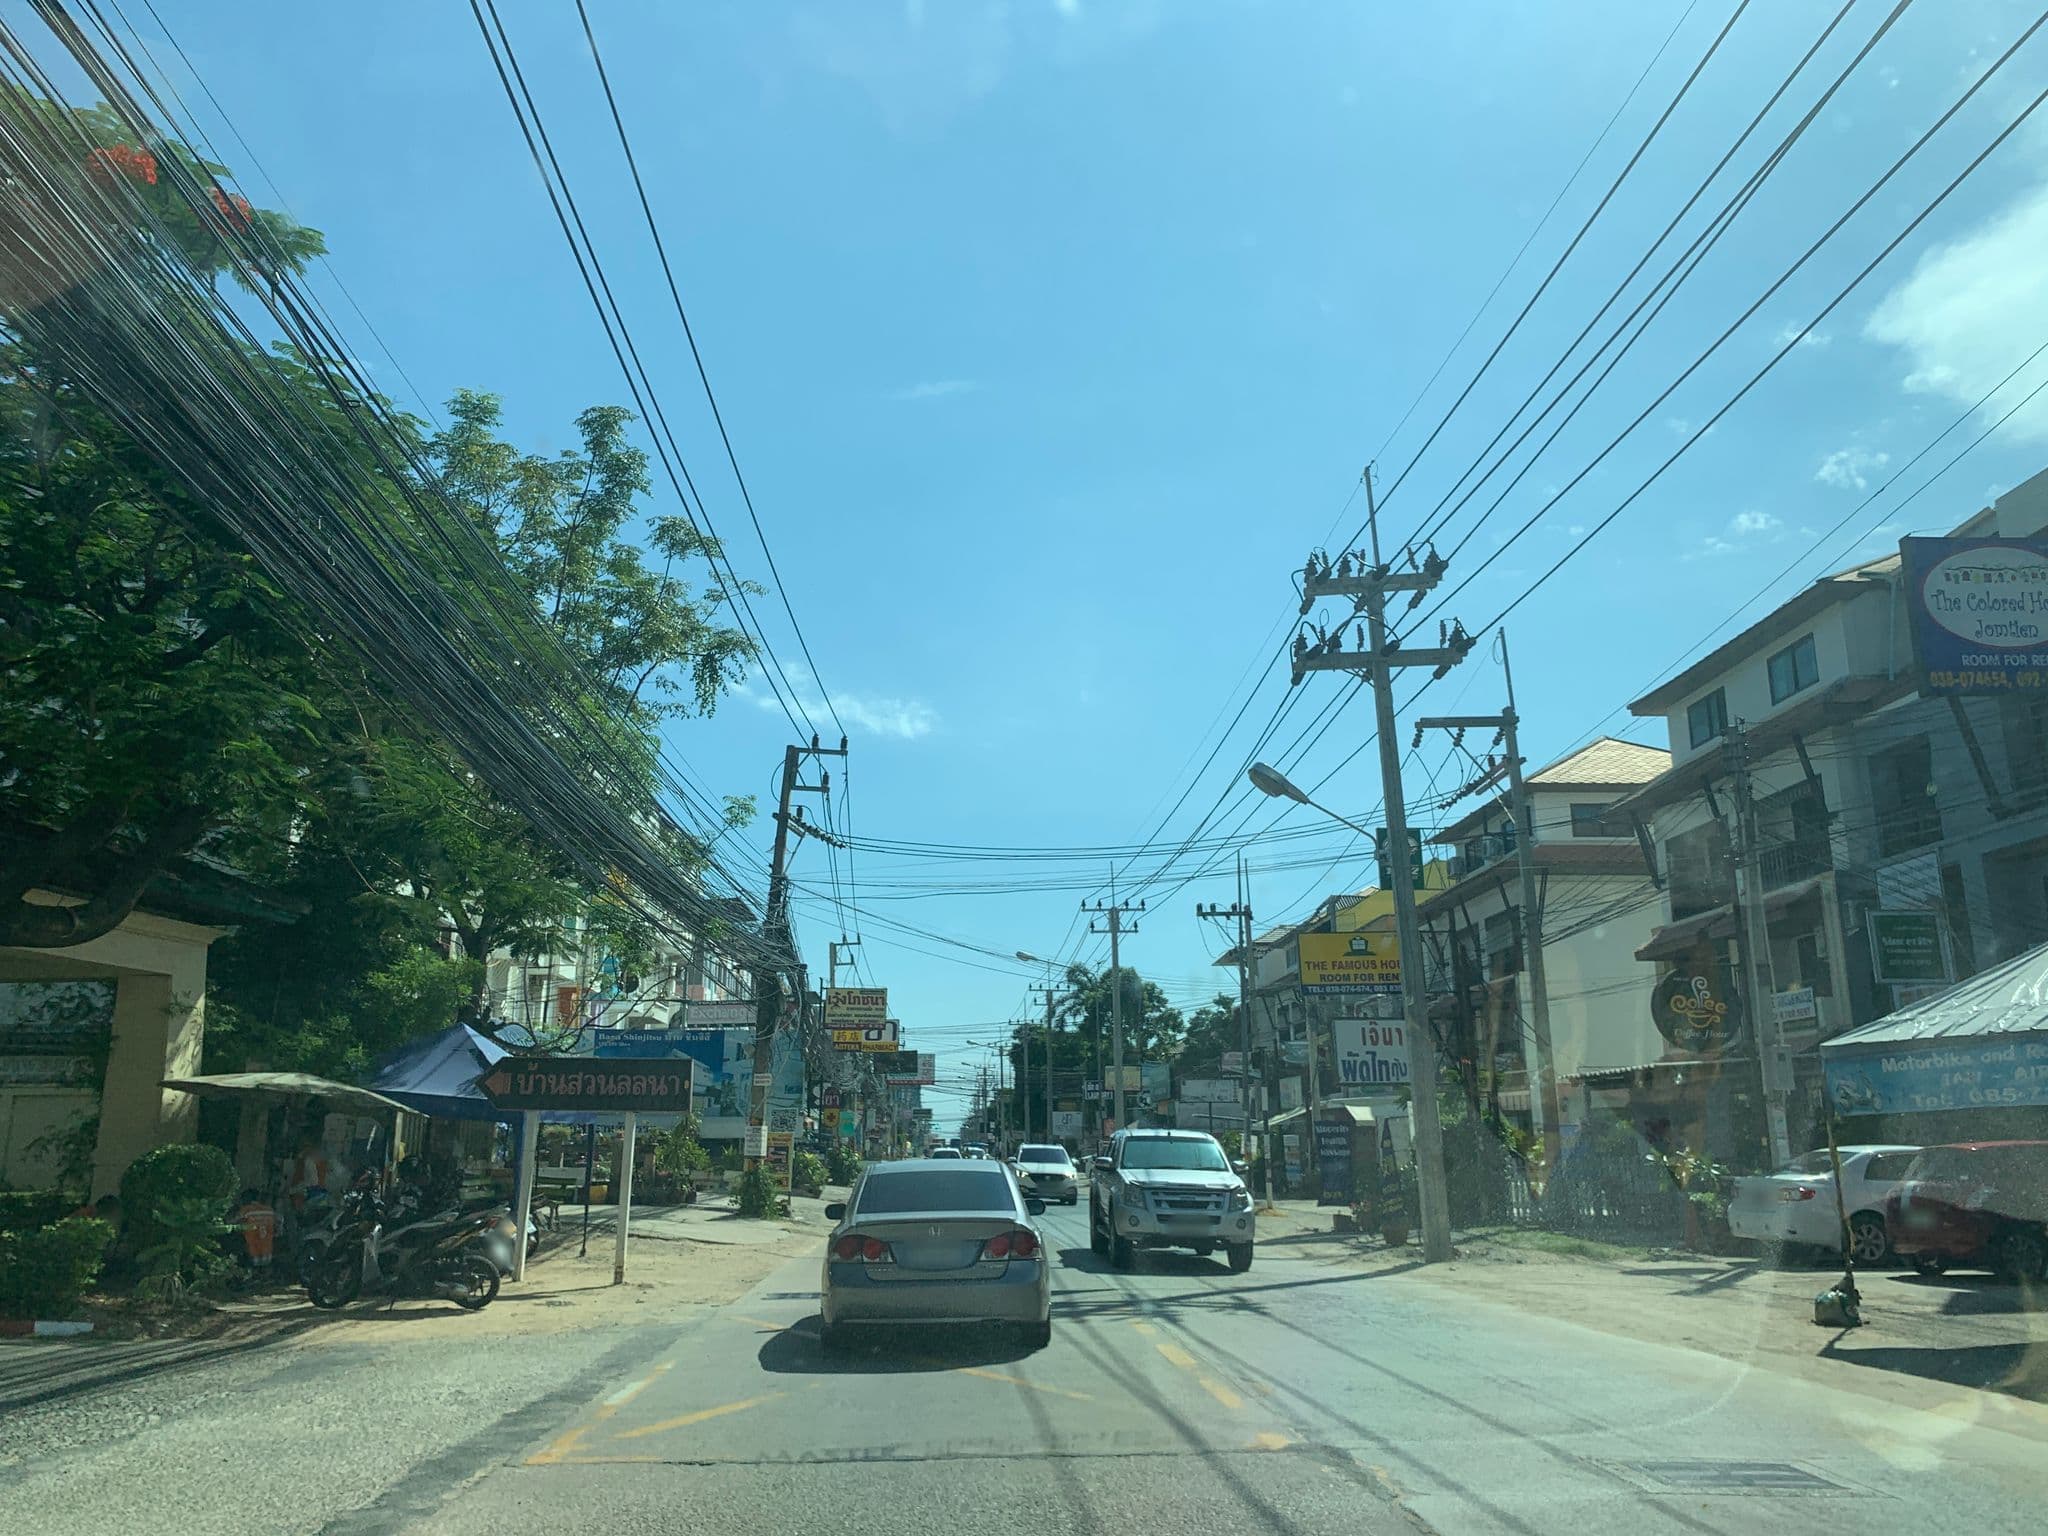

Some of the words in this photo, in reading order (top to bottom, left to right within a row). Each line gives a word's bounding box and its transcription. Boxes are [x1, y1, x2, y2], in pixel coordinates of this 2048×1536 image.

[1931, 589, 1961, 612] The
[1966, 590, 2025, 612] Colored
[1974, 619, 2039, 639] Jomtien
[1961, 654, 2000, 666] ROOM
[2004, 654, 2028, 666] FOR
[2031, 654, 2048, 666] RE
[1305, 960, 1328, 971] THE
[1331, 959, 1377, 970] FAMOUS
[1319, 974, 1350, 983] ROOM
[1354, 973, 1375, 982] FOR
[1378, 973, 1400, 982] REN
[1881, 1051, 1973, 1073] Motorbike
[1981, 1044, 2015, 1064] and
